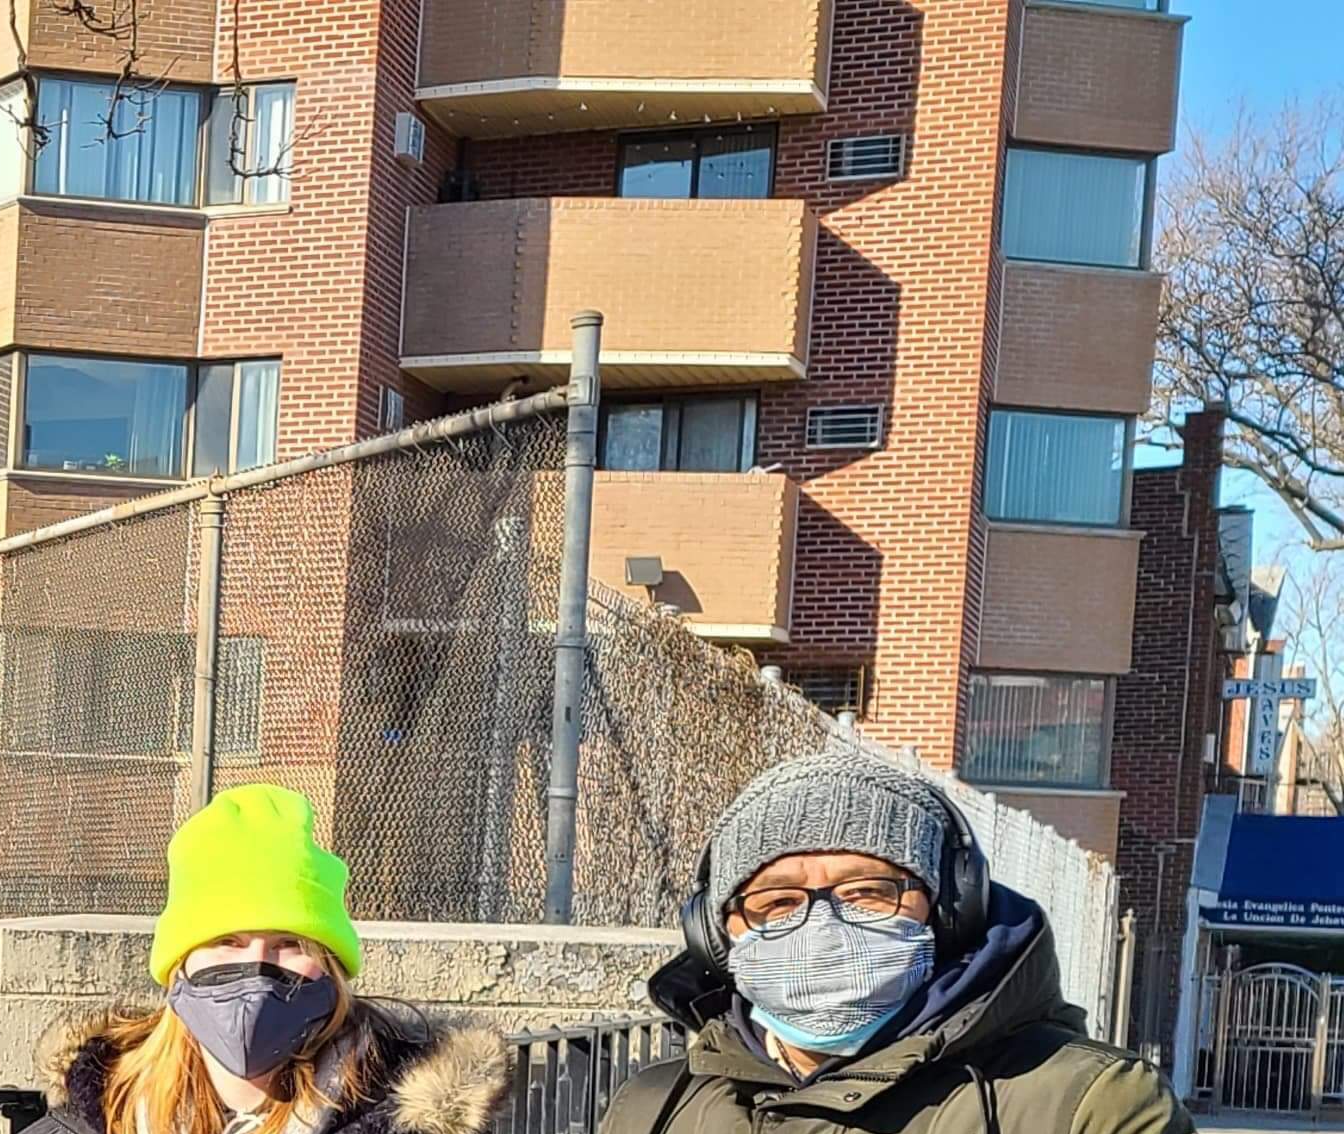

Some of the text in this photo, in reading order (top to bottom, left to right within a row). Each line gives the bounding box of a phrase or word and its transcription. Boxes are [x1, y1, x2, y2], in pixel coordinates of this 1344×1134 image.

[1227, 681, 1310, 695] JESUS
[1311, 902, 1344, 914] Pente
[1223, 911, 1238, 922] La
[1244, 911, 1284, 924] Uncion
[1290, 913, 1306, 925] De
